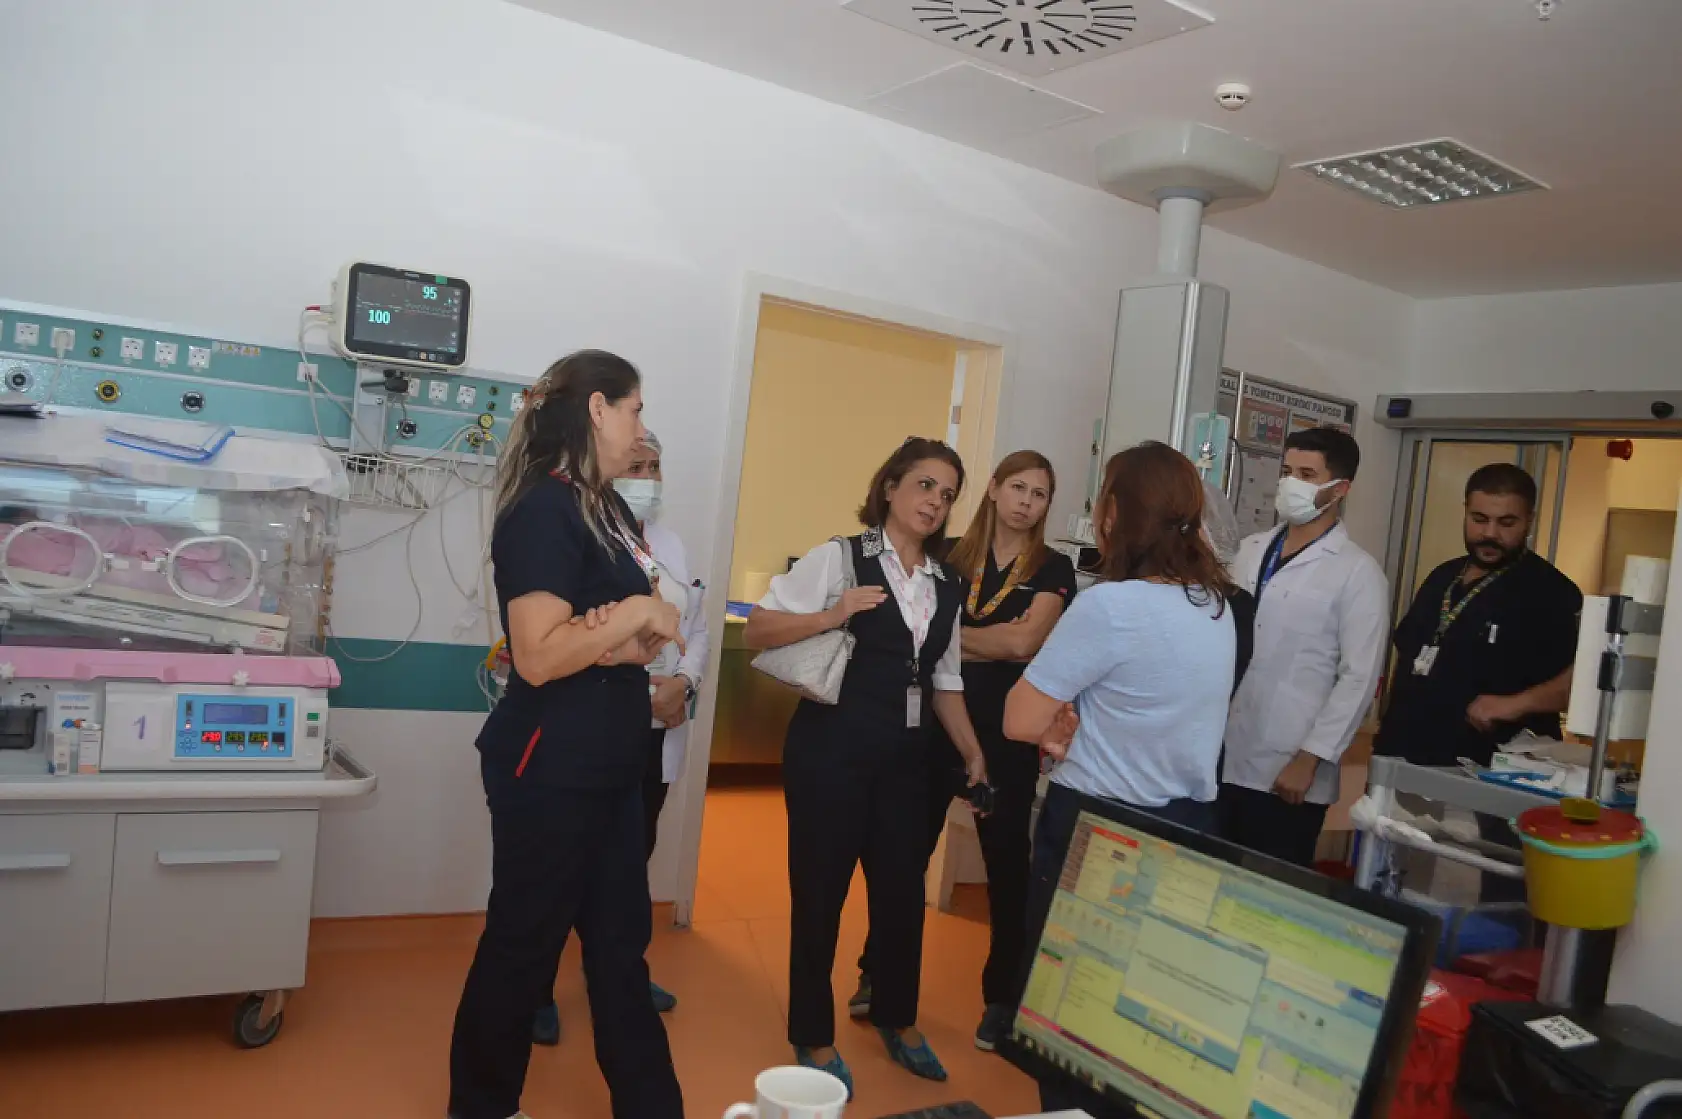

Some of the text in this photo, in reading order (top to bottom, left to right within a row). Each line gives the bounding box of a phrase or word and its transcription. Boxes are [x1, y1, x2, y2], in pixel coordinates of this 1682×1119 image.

[422, 286, 438, 300] 95
[368, 309, 391, 325] 100
[132, 715, 145, 740] 1
